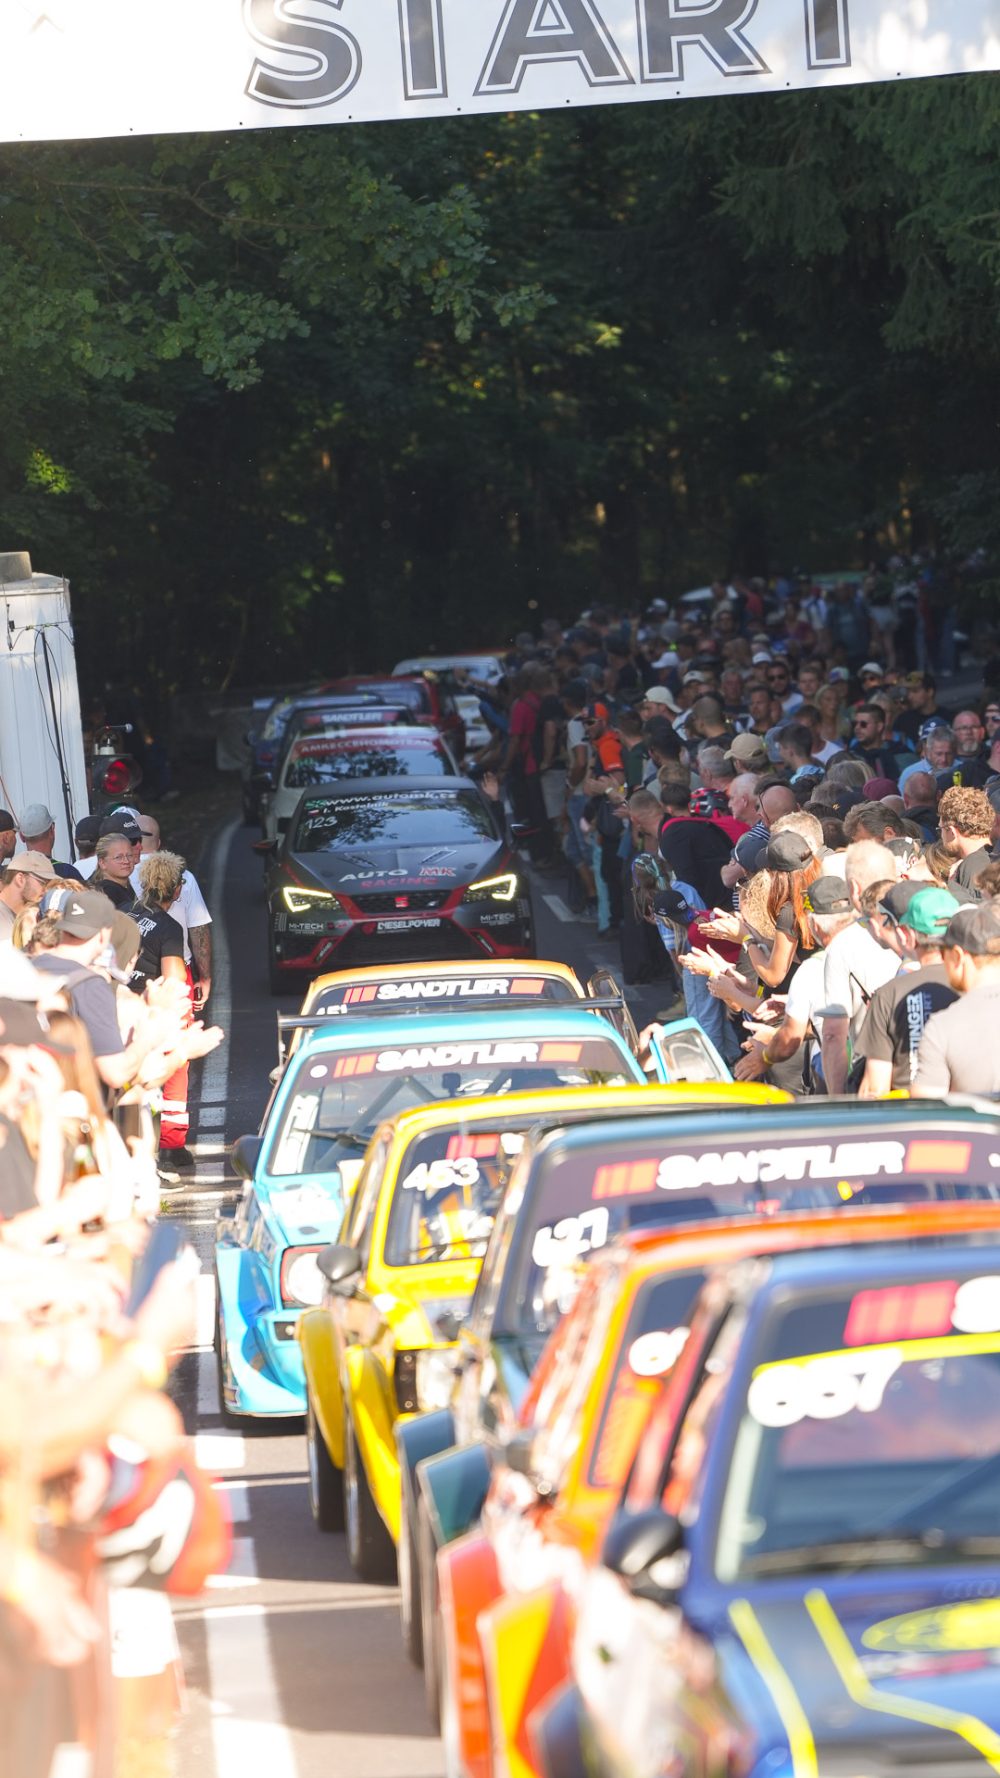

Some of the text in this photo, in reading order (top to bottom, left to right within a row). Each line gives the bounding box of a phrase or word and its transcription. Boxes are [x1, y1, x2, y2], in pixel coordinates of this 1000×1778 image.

[306, 816, 338, 830] 123
[339, 869, 408, 882] AUTO
[360, 877, 438, 888] RACING
[377, 978, 509, 1000] SANDTLER
[376, 1043, 539, 1072] SANDTLER
[402, 1157, 480, 1191] 453
[656, 1140, 905, 1190] SANDTLER
